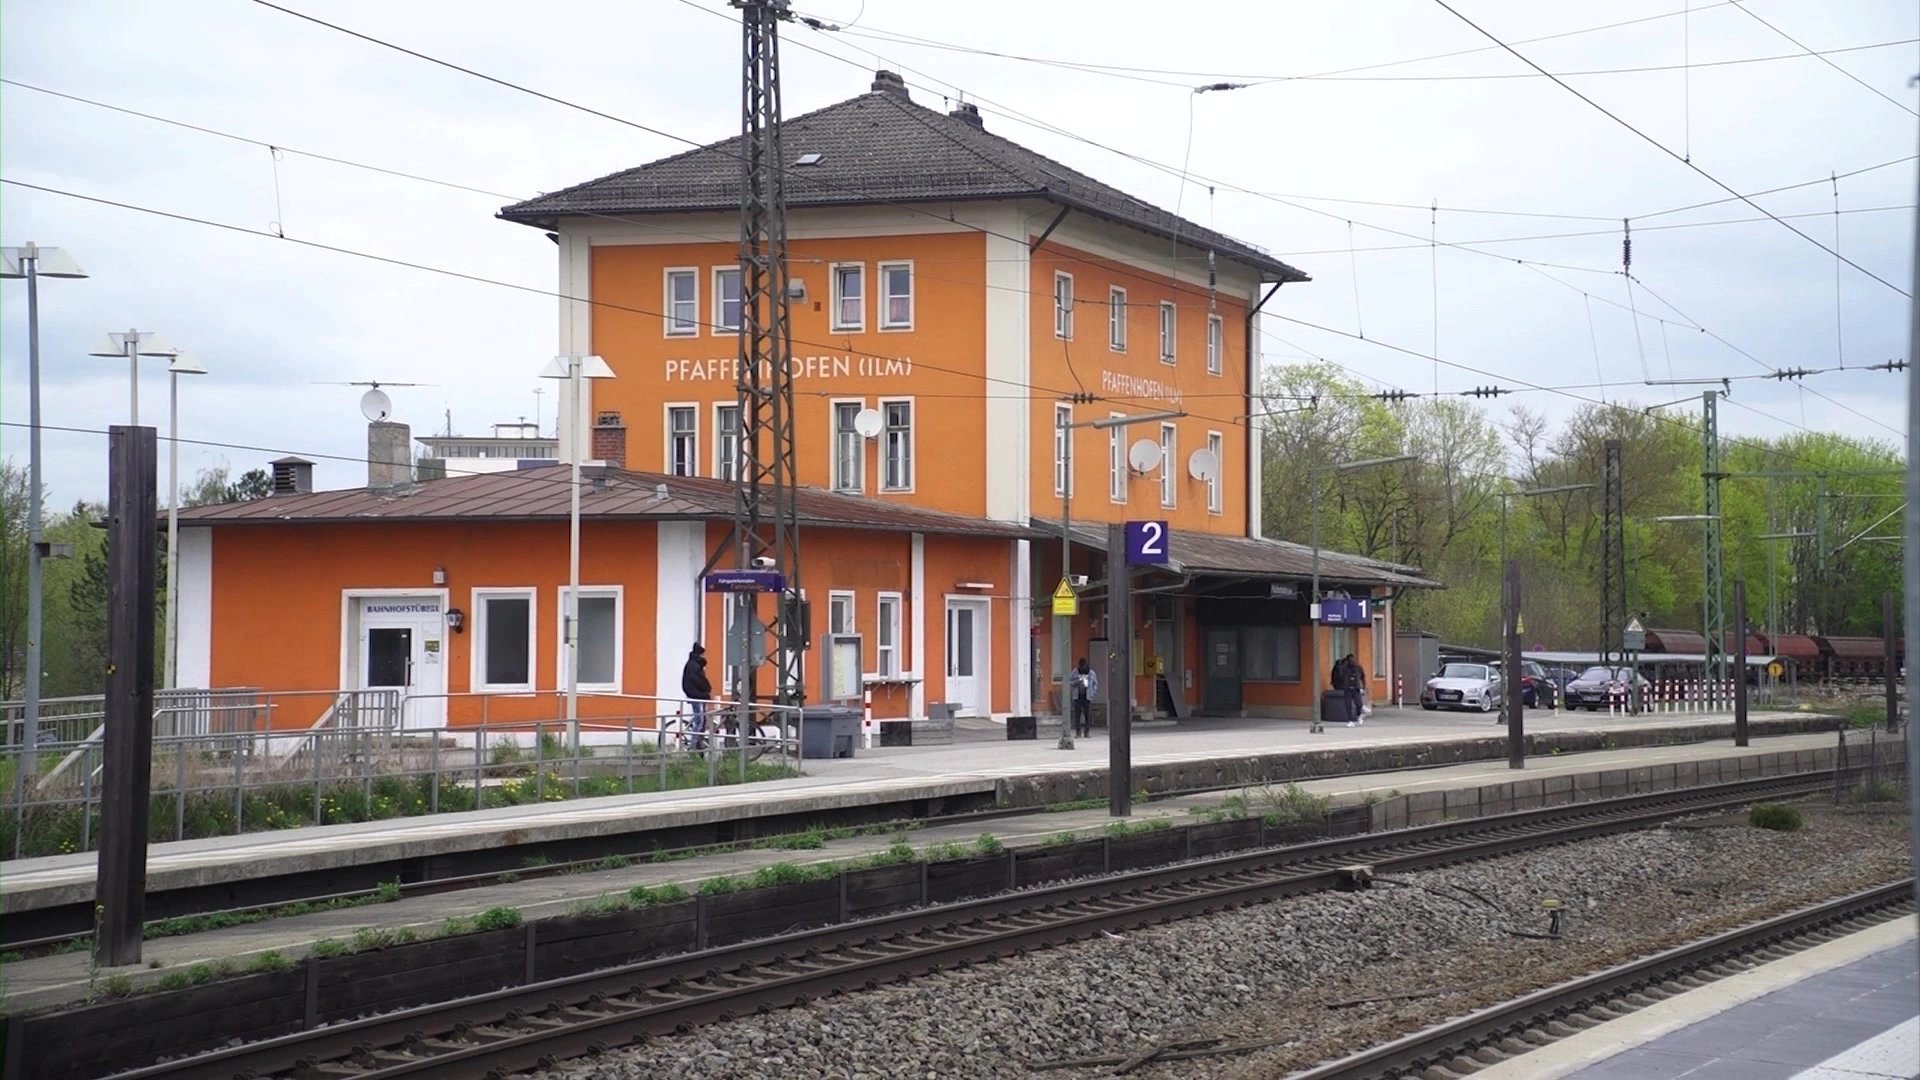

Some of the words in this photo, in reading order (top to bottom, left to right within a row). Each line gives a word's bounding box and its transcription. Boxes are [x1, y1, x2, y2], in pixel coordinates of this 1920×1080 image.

[859, 357, 912, 377] (ILM)
[1141, 521, 1162, 554] 2
[1358, 599, 1367, 618] 1
